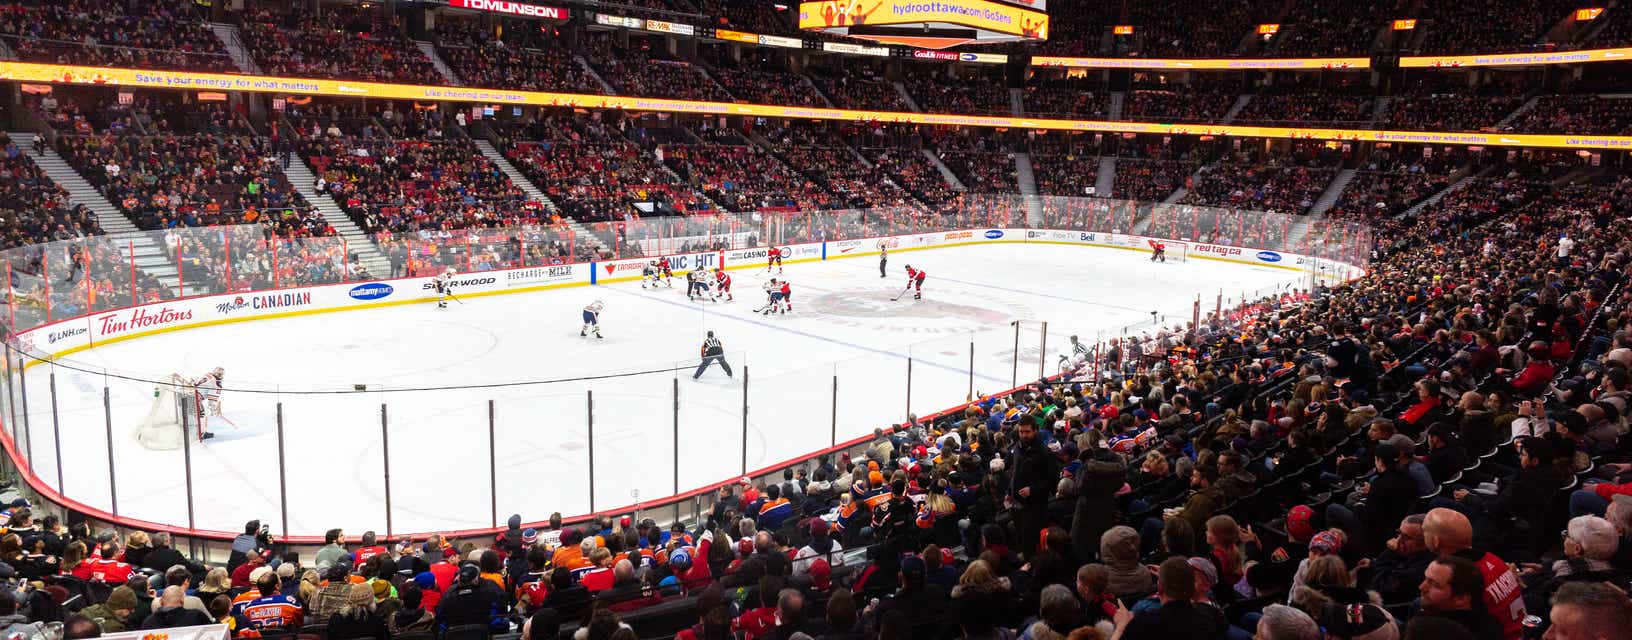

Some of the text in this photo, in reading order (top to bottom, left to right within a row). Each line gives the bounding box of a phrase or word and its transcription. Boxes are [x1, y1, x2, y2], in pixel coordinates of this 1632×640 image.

[463, 0, 559, 19] TOMLINSON
[893, 3, 1012, 24] hydroottawa.com/GoSens
[136, 74, 319, 91] Save your energy for what matters
[424, 89, 441, 97] Like
[444, 90, 477, 99] cheering
[1081, 232, 1096, 241] Bell
[695, 253, 716, 268] HIT
[744, 250, 767, 259] CASINO
[549, 265, 572, 277] MILK
[253, 292, 311, 309] CANADIAN
[99, 307, 193, 336] Tim Hortons
